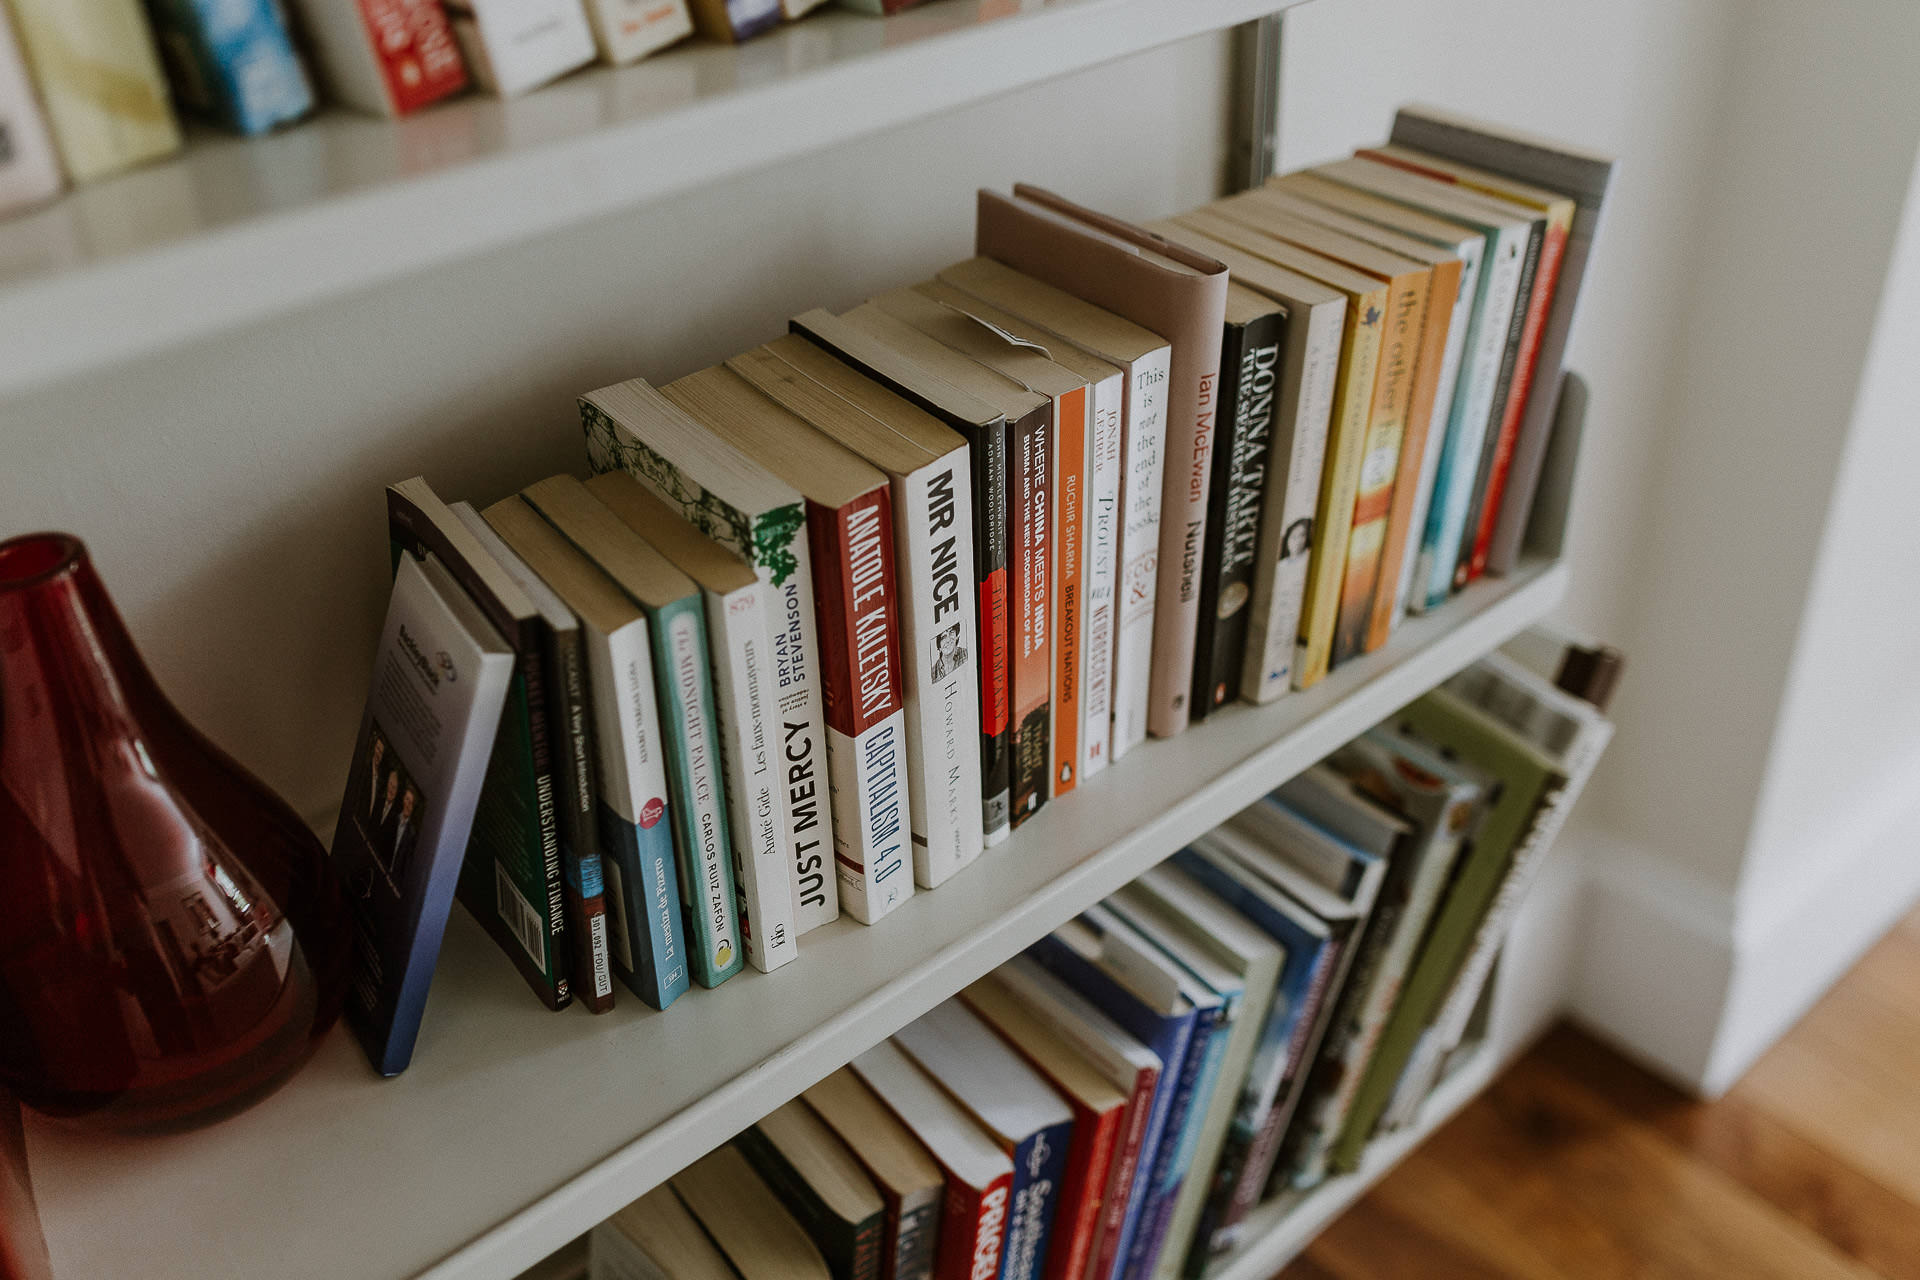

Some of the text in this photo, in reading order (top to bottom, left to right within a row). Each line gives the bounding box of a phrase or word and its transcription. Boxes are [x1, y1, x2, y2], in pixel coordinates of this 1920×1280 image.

[1137, 367, 1164, 391] This
[1238, 347, 1256, 395] THE
[1143, 392, 1153, 408] is
[1095, 408, 1105, 473] LEHRER
[1106, 409, 1117, 462] JONAH
[1134, 449, 1156, 474] end
[1190, 373, 1216, 503] Ian McEwan
[1233, 342, 1279, 567] DONNA TARTT
[927, 468, 959, 624] MR NICE
[1023, 523, 1031, 548] NEW
[1034, 424, 1045, 651] WHERE CHINA MEETS INDIA
[1096, 490, 1114, 575] PROUST
[1023, 550, 1031, 617] CROSSROADS
[1062, 474, 1076, 704] RUCHIR SHARMA BREAKOUT NATIONS
[1181, 520, 1203, 604] Nutshell
[785, 583, 806, 682] STEVENSON
[847, 505, 892, 718] ANATOLE KALETSKY
[1024, 618, 1030, 633] OF
[775, 633, 791, 688] BRYAN
[992, 584, 1004, 720] THE COMPANY
[570, 704, 580, 713] A
[680, 654, 702, 740] MIDNIGHT
[571, 714, 582, 735] Very
[574, 734, 586, 760] Short
[744, 640, 776, 856] André Gide Les faux-monnayeurs
[691, 744, 710, 805] PALACE
[944, 681, 960, 825] HOWARD MARKS
[577, 760, 590, 813] Introduction
[865, 726, 902, 884] CAPITALISM 4.0
[702, 812, 716, 861] CARLOS
[783, 721, 827, 907] JUST MERCY
[537, 774, 559, 879] UNDERSTANDING
[548, 880, 565, 936] FINANCE
[655, 857, 666, 897] Pizarro
[708, 862, 720, 892] RUIZ
[658, 894, 669, 909] de
[661, 908, 674, 946] mestiza
[712, 893, 727, 933] ZAFÓN
[665, 945, 675, 960] La
[771, 923, 786, 950] folio
[594, 952, 608, 994] FOU/GUT
